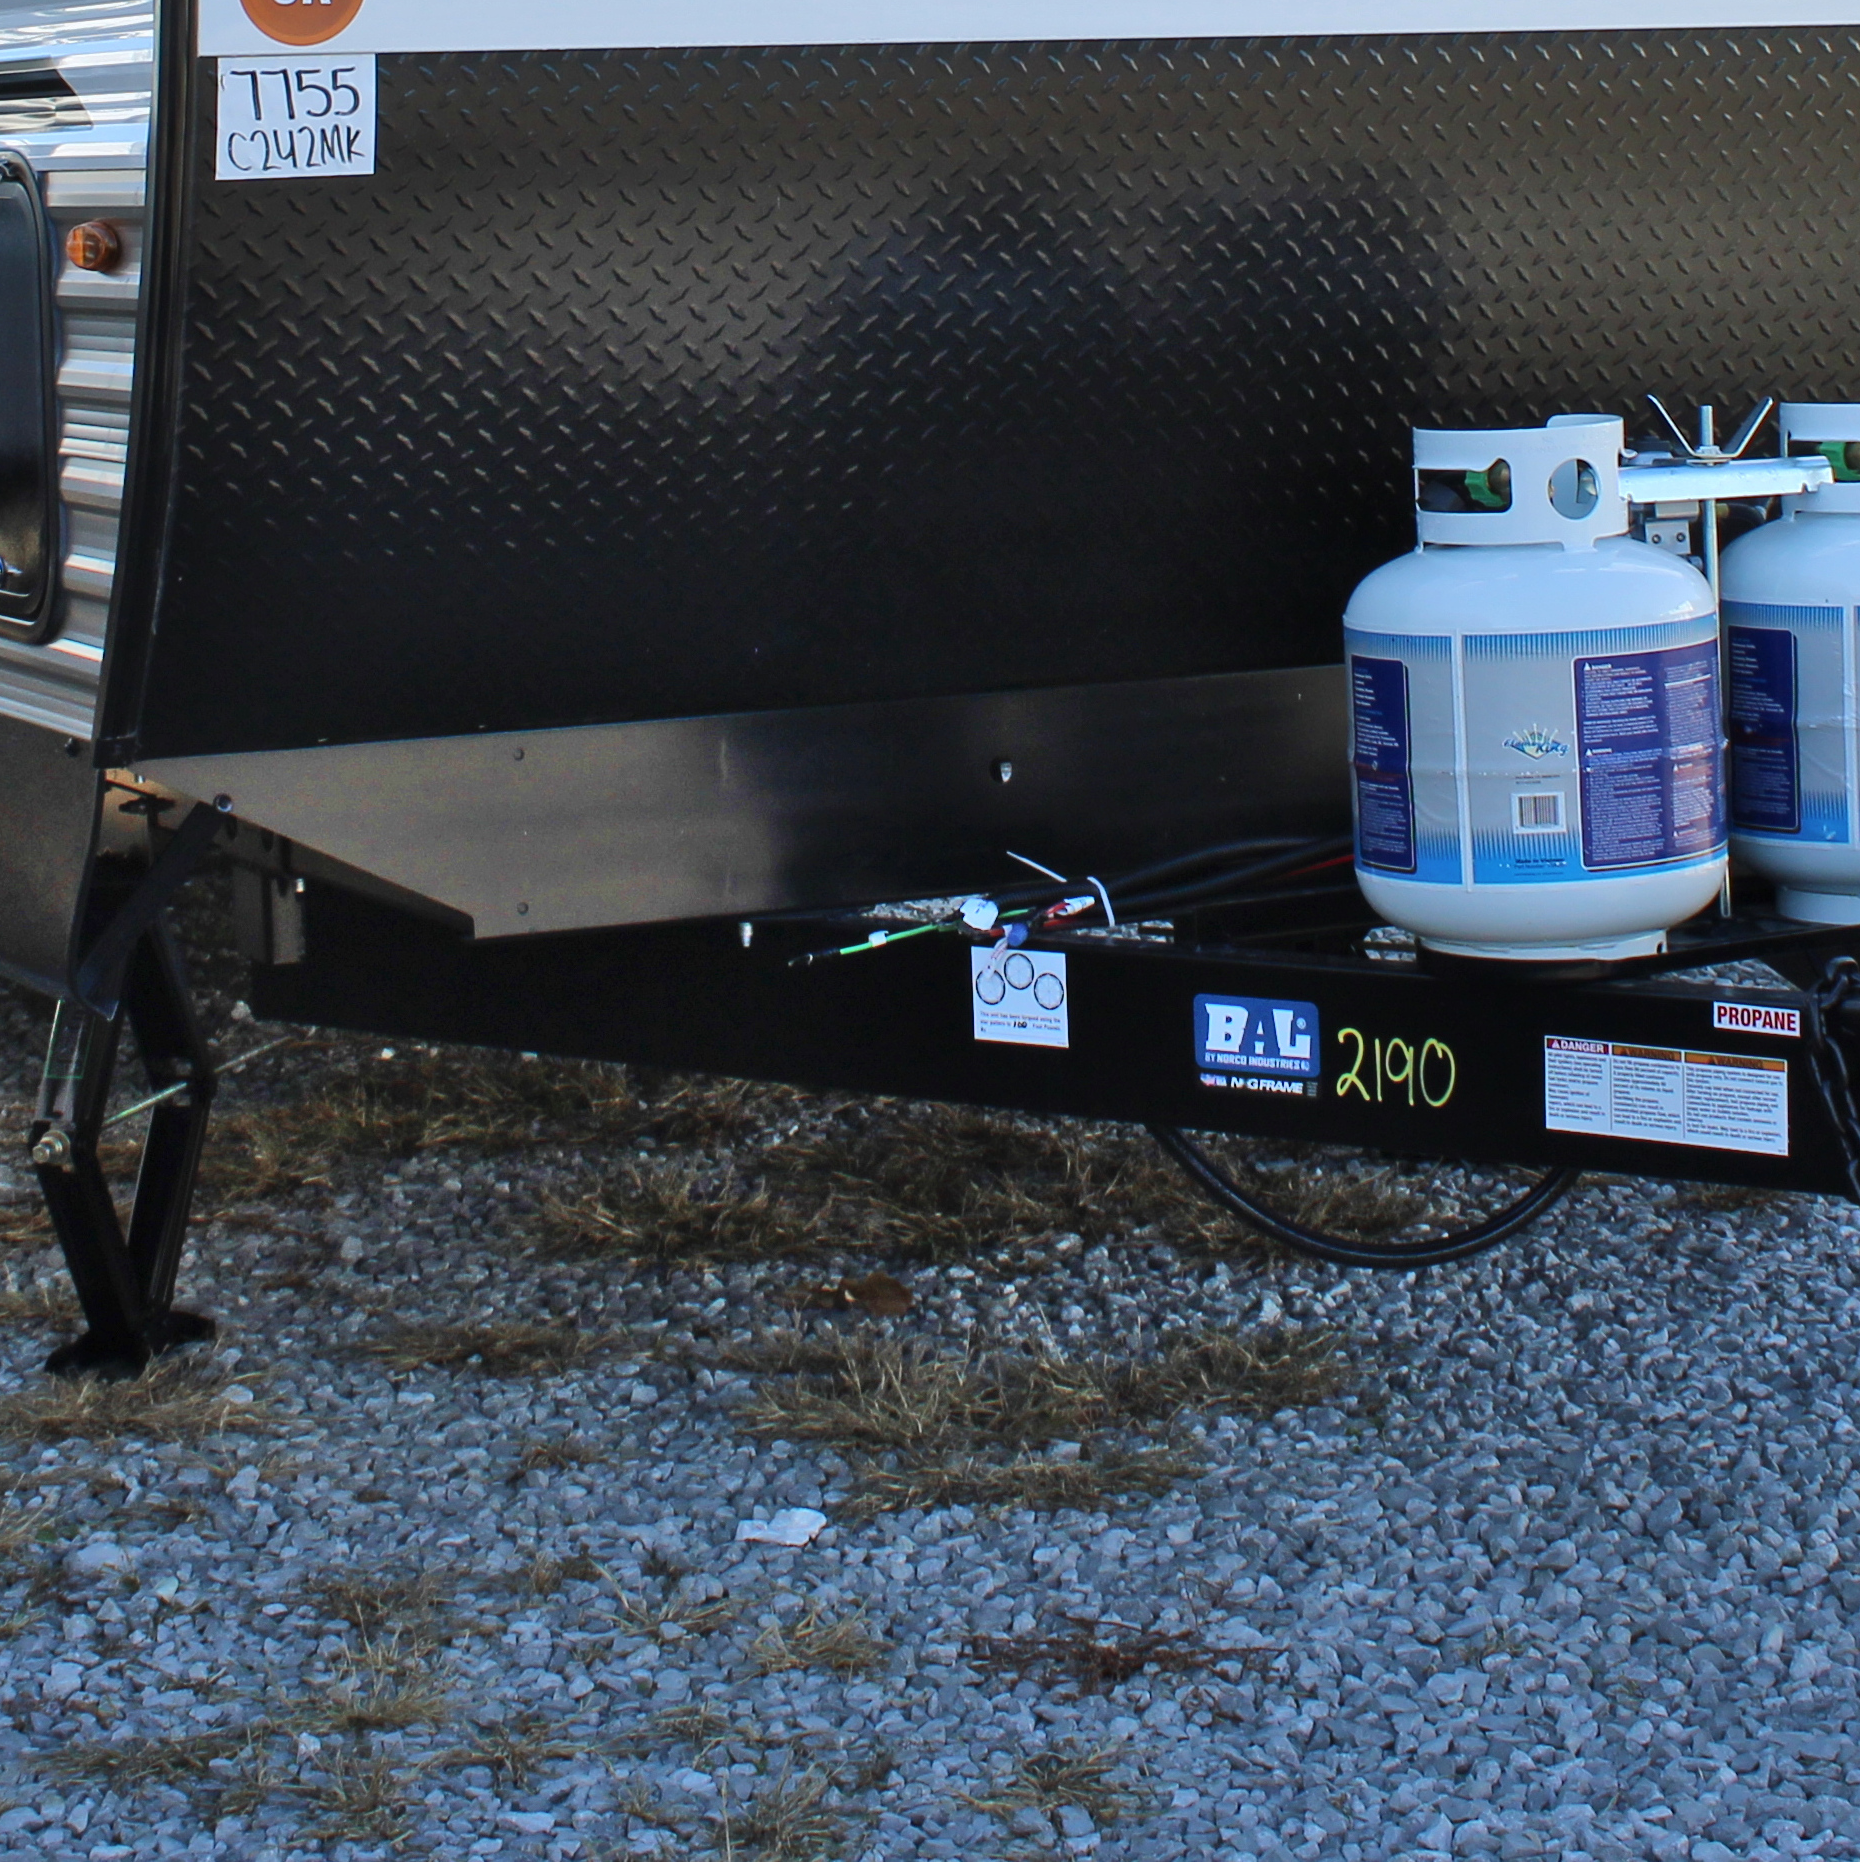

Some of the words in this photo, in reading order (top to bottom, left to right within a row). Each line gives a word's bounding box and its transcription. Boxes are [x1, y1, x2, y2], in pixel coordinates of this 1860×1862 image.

[229, 65, 361, 121] 7755
[227, 123, 365, 172] C242MK
[1204, 1003, 1311, 1059] BAL
[1717, 1005, 1797, 1032] PROPANE
[1217, 1053, 1248, 1066] NORCO
[1559, 1039, 1605, 1053] DANGER
[1259, 1079, 1304, 1095] FRAME
[1336, 1027, 1457, 1109] 2190
